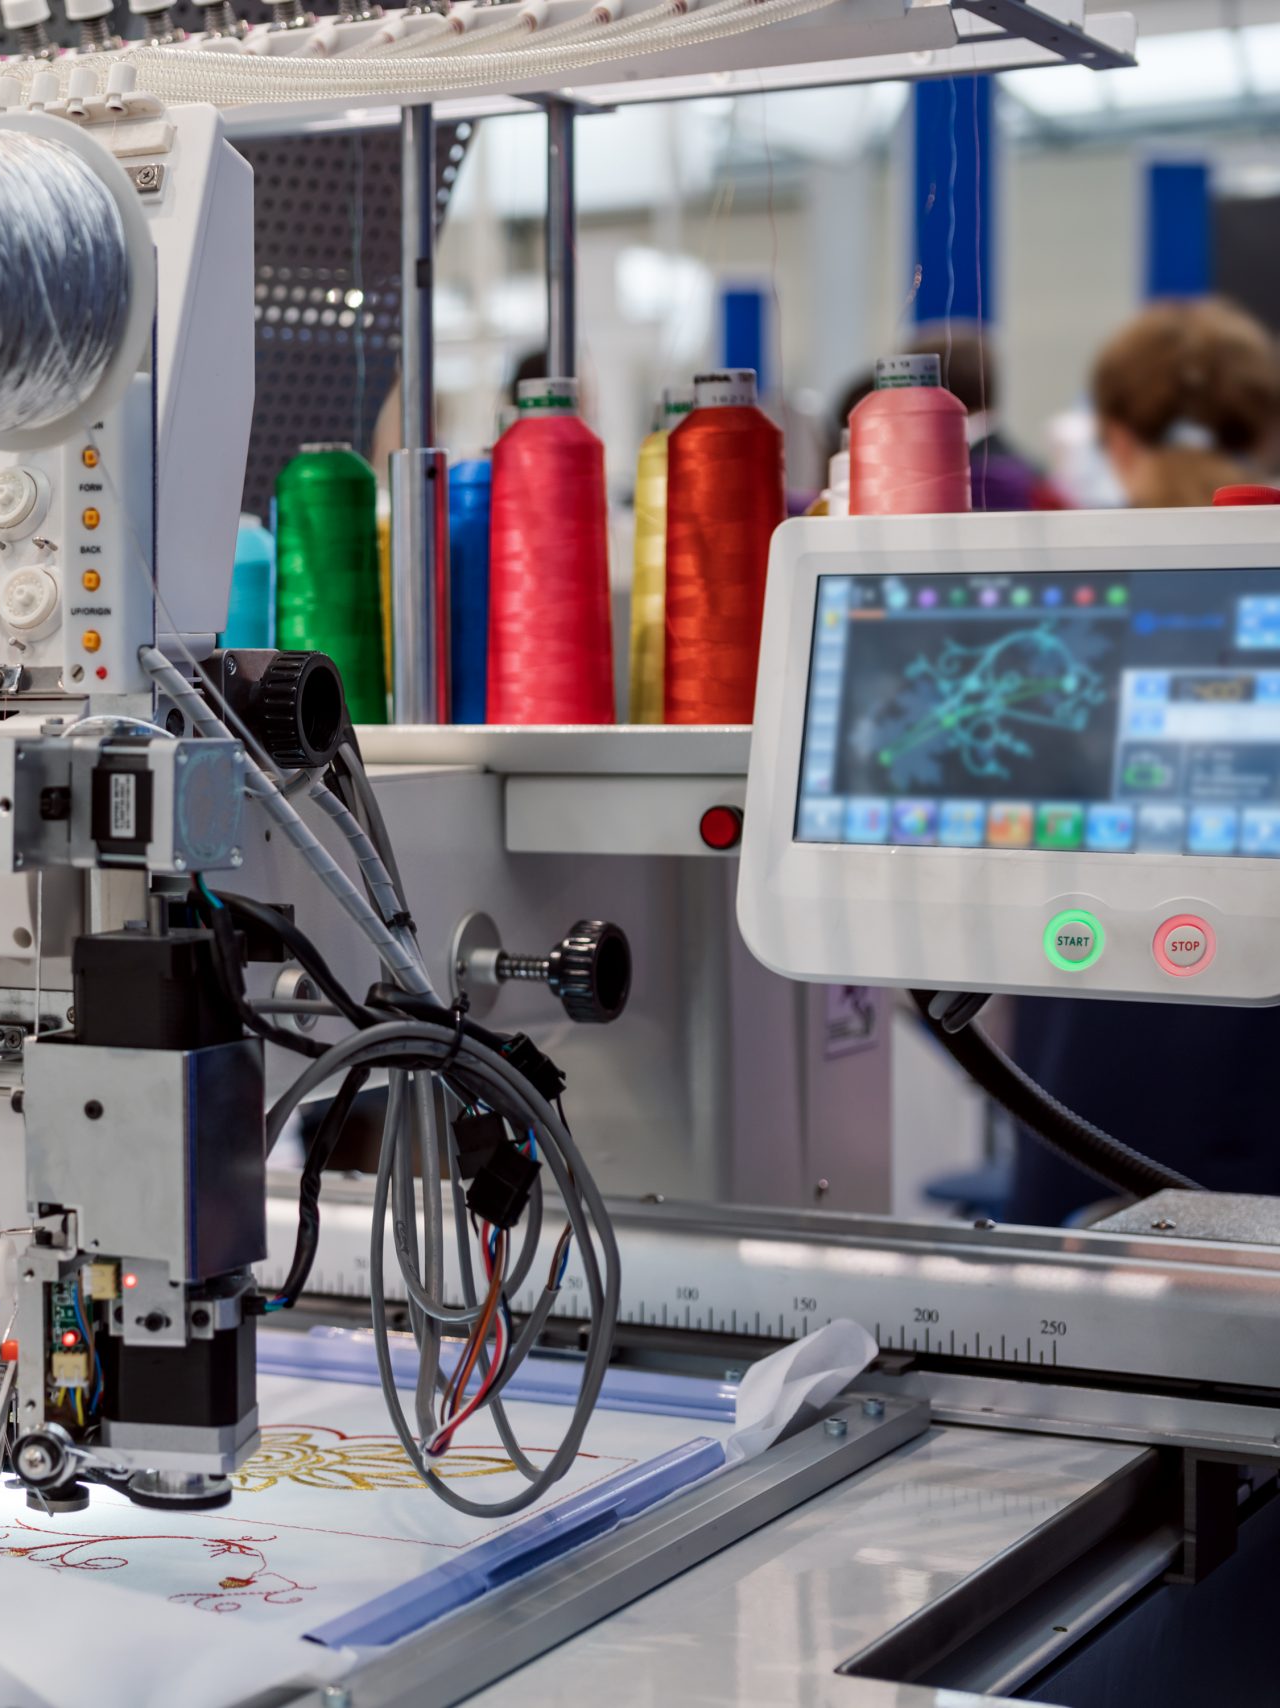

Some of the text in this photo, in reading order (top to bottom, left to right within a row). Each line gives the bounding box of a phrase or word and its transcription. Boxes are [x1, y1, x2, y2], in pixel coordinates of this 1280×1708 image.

[80, 545, 102, 554] BACK
[70, 607, 112, 616] UP/ORIGIN
[1057, 936, 1090, 947] START
[1171, 941, 1200, 952] STOP
[676, 1286, 699, 1301] 100
[793, 1296, 817, 1312] 150
[913, 1307, 939, 1324] 200
[1040, 1319, 1067, 1336] 250
